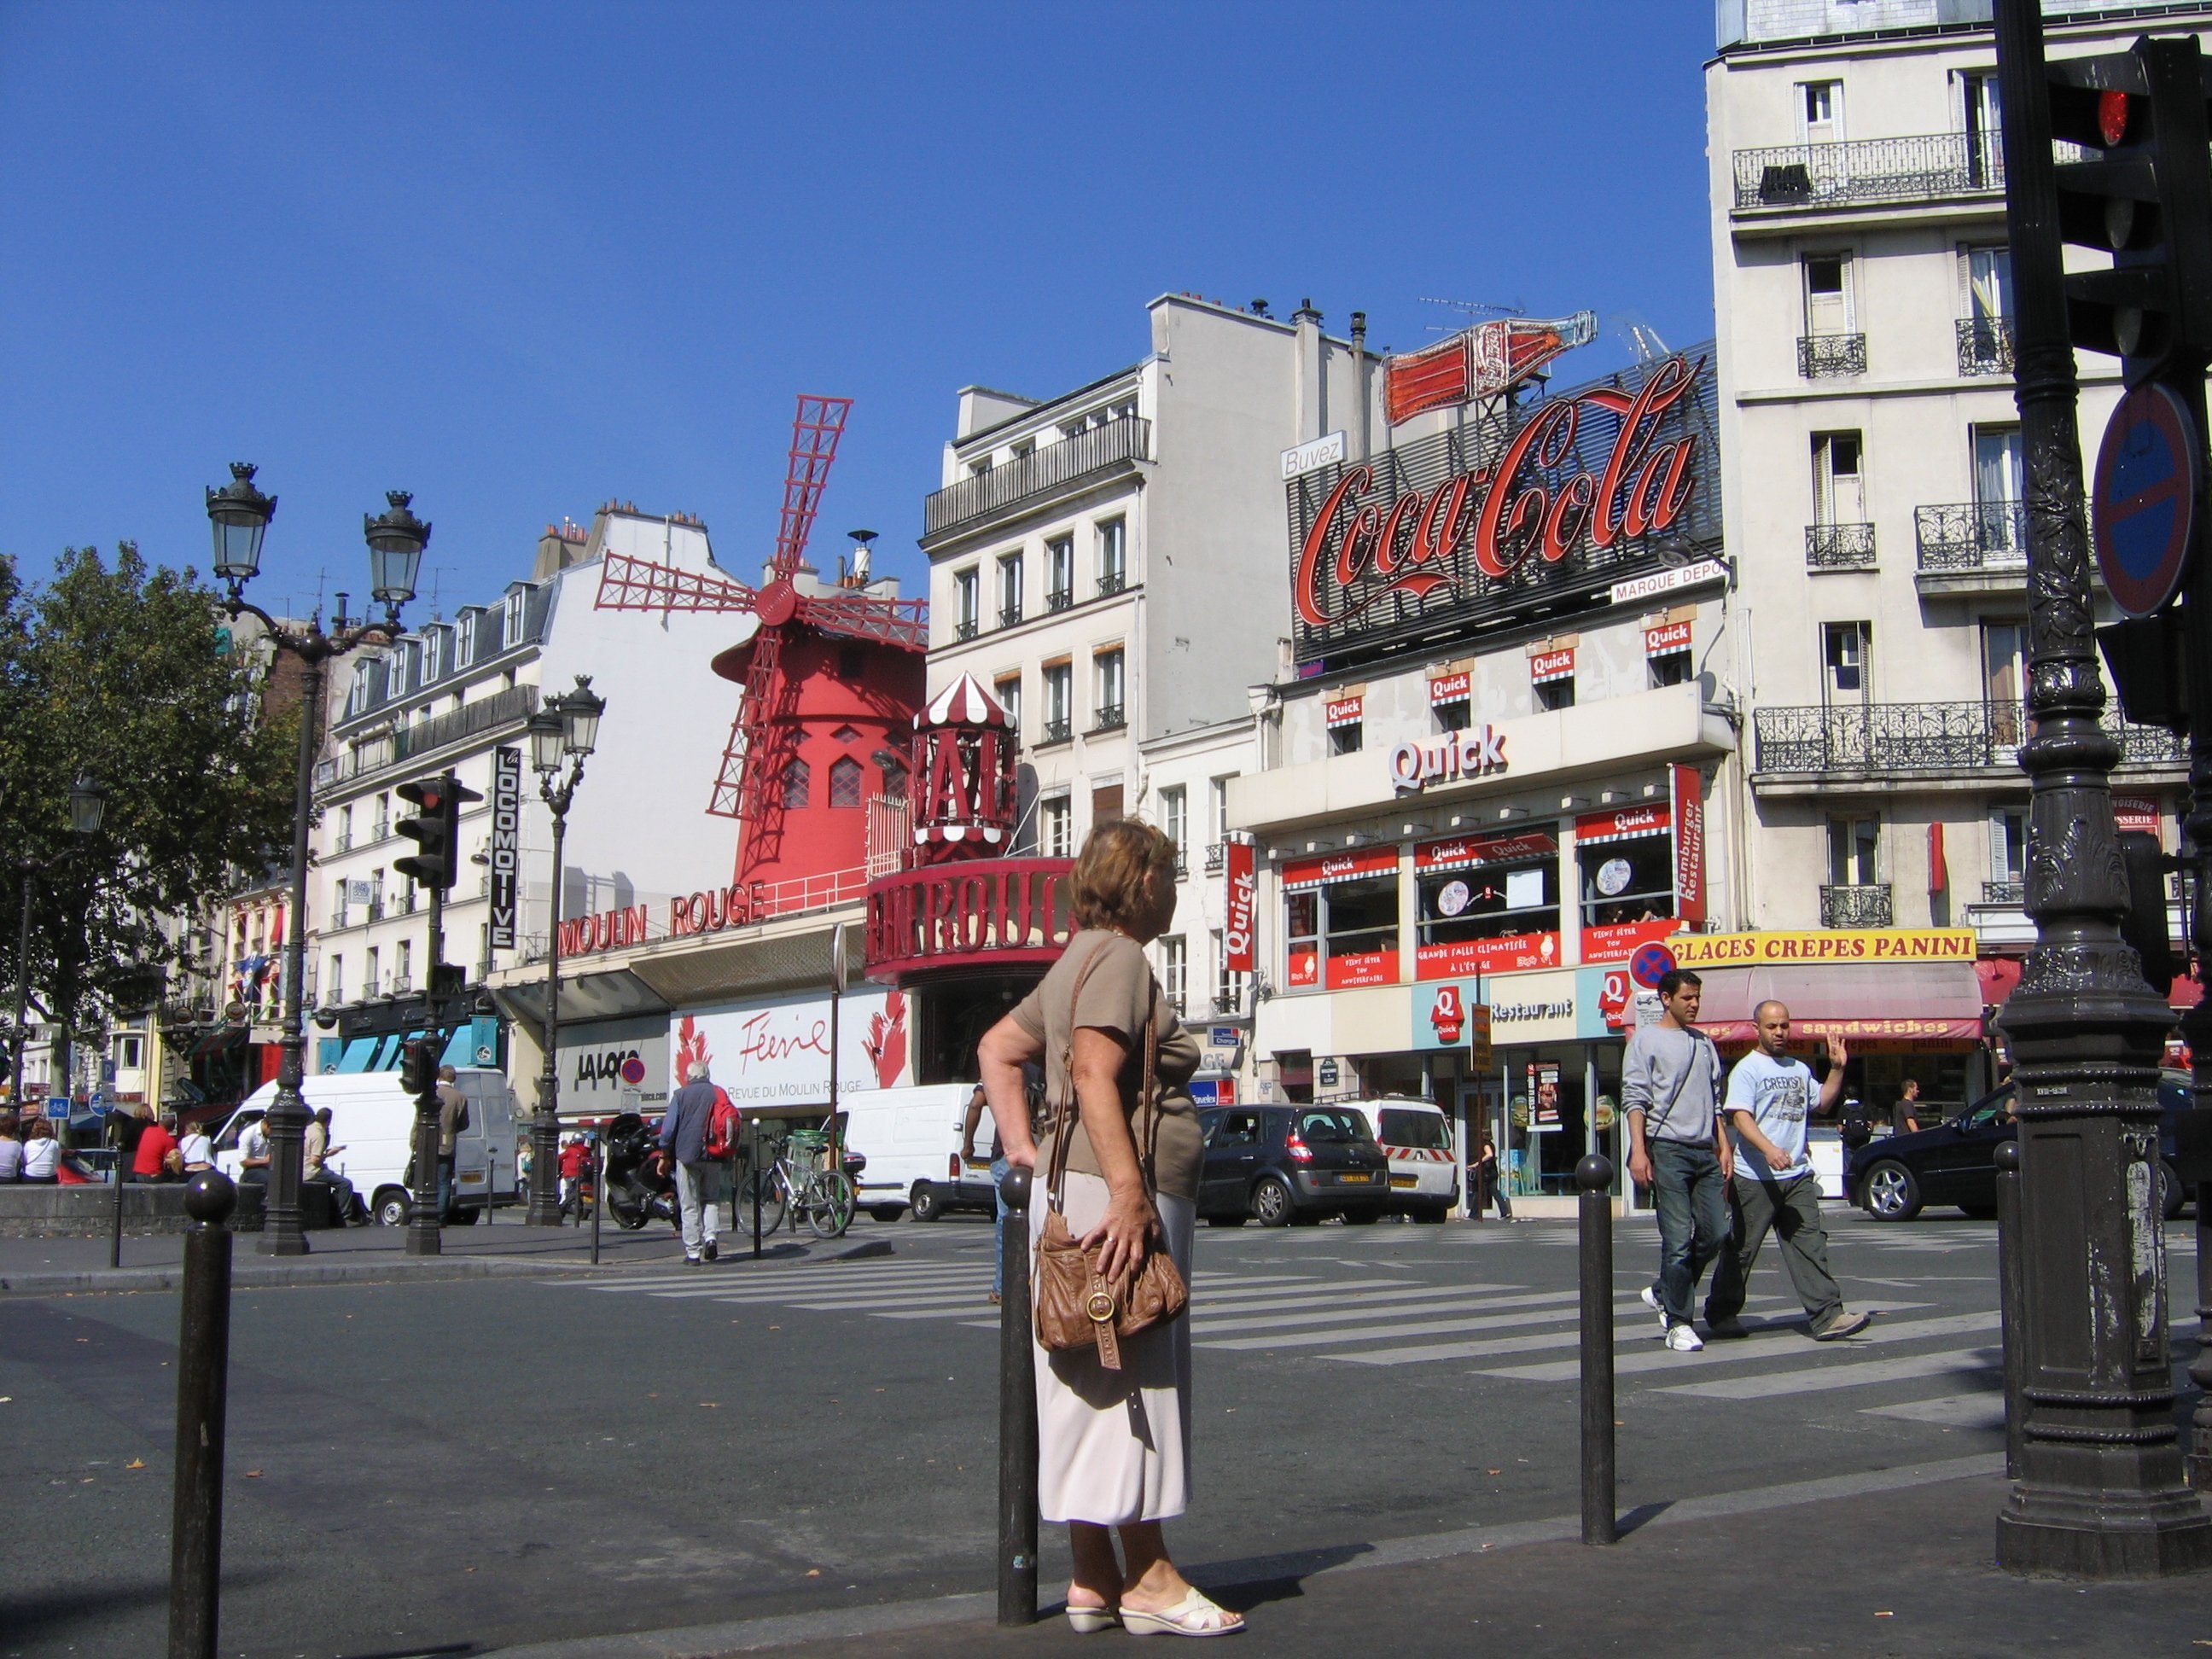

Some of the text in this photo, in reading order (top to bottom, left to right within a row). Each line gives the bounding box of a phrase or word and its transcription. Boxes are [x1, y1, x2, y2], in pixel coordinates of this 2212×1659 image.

[1285, 442, 1339, 475] Buvez
[1294, 353, 1707, 626] Coca-Cola
[1615, 573, 1676, 600] MARQUE
[1648, 624, 1688, 649] Quick
[1534, 651, 1571, 675] Quick
[1433, 675, 1467, 697] Quick
[1329, 699, 1359, 720] Quick
[1388, 724, 1507, 792] Quick
[1614, 808, 1656, 831] Quick
[492, 754, 518, 946] LOCOMOTIVE
[1431, 841, 1467, 863] Quick
[1492, 841, 1534, 856] Quick
[1675, 798, 1695, 897] Hamburger
[1685, 804, 1704, 902] Restaurant
[1322, 857, 1355, 876] Quick
[558, 880, 765, 957] MOULIN ROUGE
[1226, 870, 1254, 956] Quick
[1417, 949, 1448, 960] GRANDE
[1452, 945, 1474, 957] SALLE
[1671, 933, 1972, 962] GLACES CRÊPES PANINI
[1605, 975, 1625, 1003] Q
[1438, 991, 1454, 1016] Q
[1438, 1025, 1457, 1034] Quick
[1802, 1020, 1948, 1034] sandwiches
[1216, 1037, 1236, 1045] Change
[105, 1066, 112, 1077] P
[579, 1054, 596, 1081] LA
[728, 1086, 760, 1100] REVUE
[762, 1086, 777, 1098] DU
[779, 1083, 820, 1097] MOULIN
